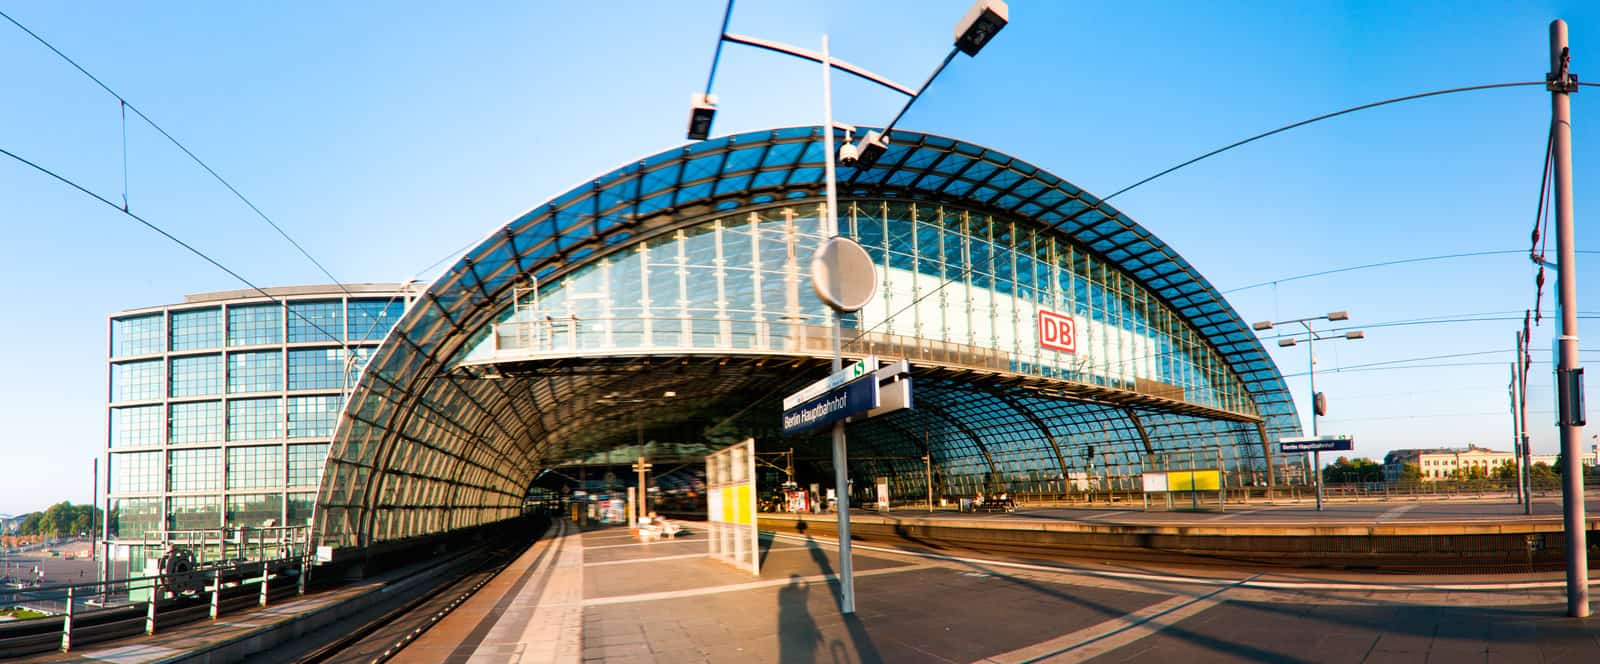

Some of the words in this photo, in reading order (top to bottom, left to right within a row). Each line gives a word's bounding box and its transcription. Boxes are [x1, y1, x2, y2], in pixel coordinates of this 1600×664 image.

[1044, 317, 1072, 345] DB
[854, 361, 864, 376] S
[784, 415, 801, 429] Berlin
[801, 392, 847, 423] Hauptbahnhof
